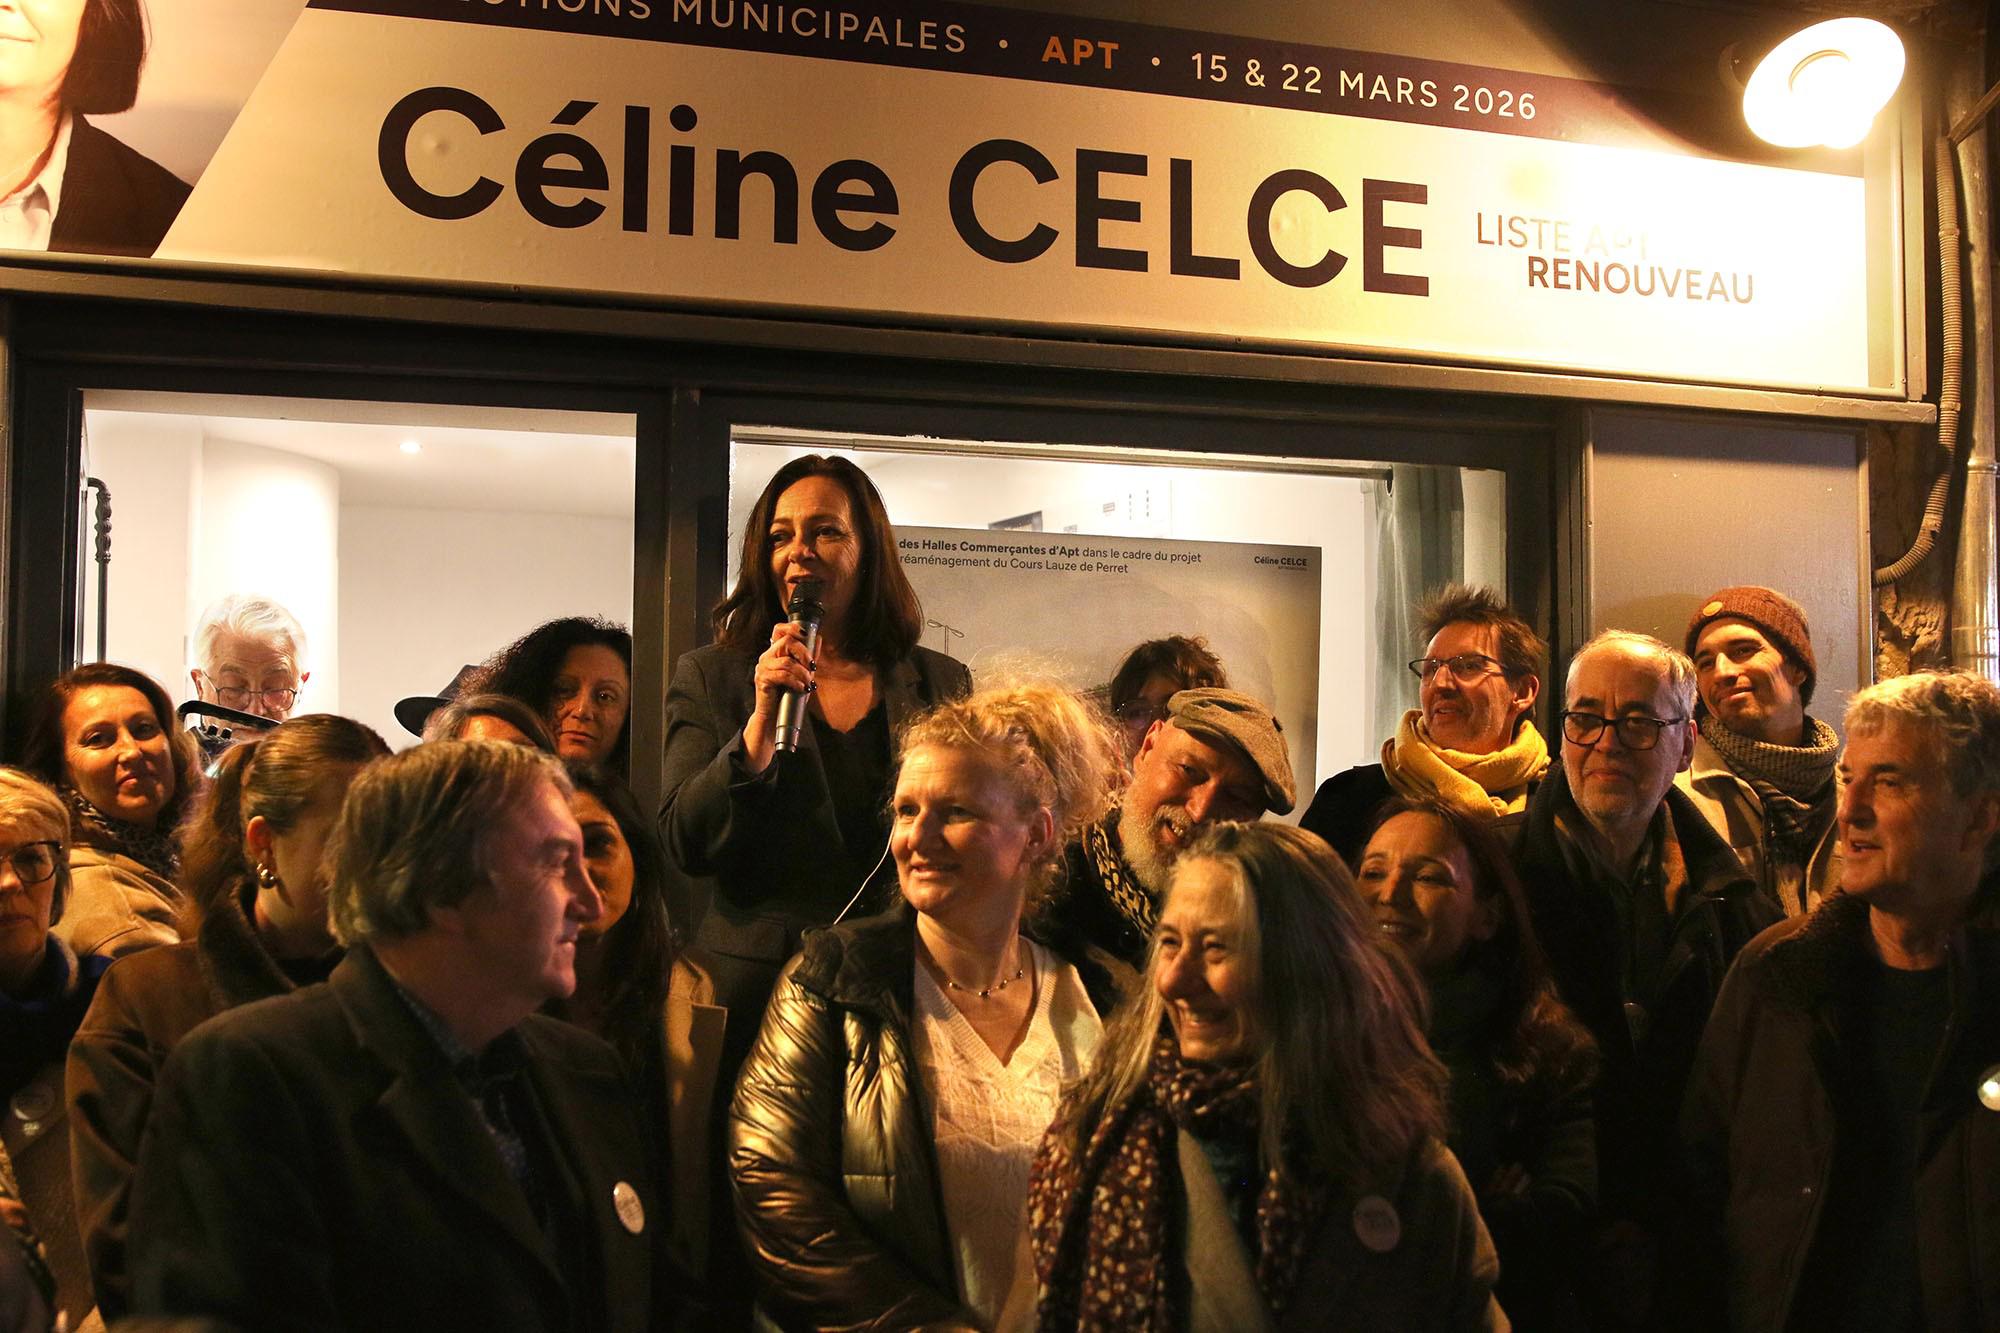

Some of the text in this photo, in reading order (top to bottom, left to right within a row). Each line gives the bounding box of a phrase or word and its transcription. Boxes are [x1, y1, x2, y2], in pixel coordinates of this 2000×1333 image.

[673, 0, 965, 53] MUNICIPALES
[1041, 36, 1119, 69] APT
[1191, 52, 1228, 83] 15
[1245, 58, 1266, 88] &
[1281, 63, 1322, 94] 22
[1340, 71, 1438, 108] MARS
[1453, 85, 1536, 120] 2026
[378, 86, 1430, 297] Céline CELCE
[1477, 212, 1570, 252] LISTE
[1528, 255, 1753, 304] RENOUVEAU
[899, 539, 919, 549] des
[922, 540, 957, 551] Halles
[960, 541, 1046, 556] Commerçantes
[1082, 547, 1107, 558] dans
[1110, 548, 1120, 559] le
[1122, 550, 1151, 560] cadre
[1155, 551, 1168, 561] du
[1171, 552, 1202, 565] projet
[900, 553, 1128, 574] réaménagement du Cours Lauze de Perret
[1254, 556, 1308, 567] Céline CELCE
